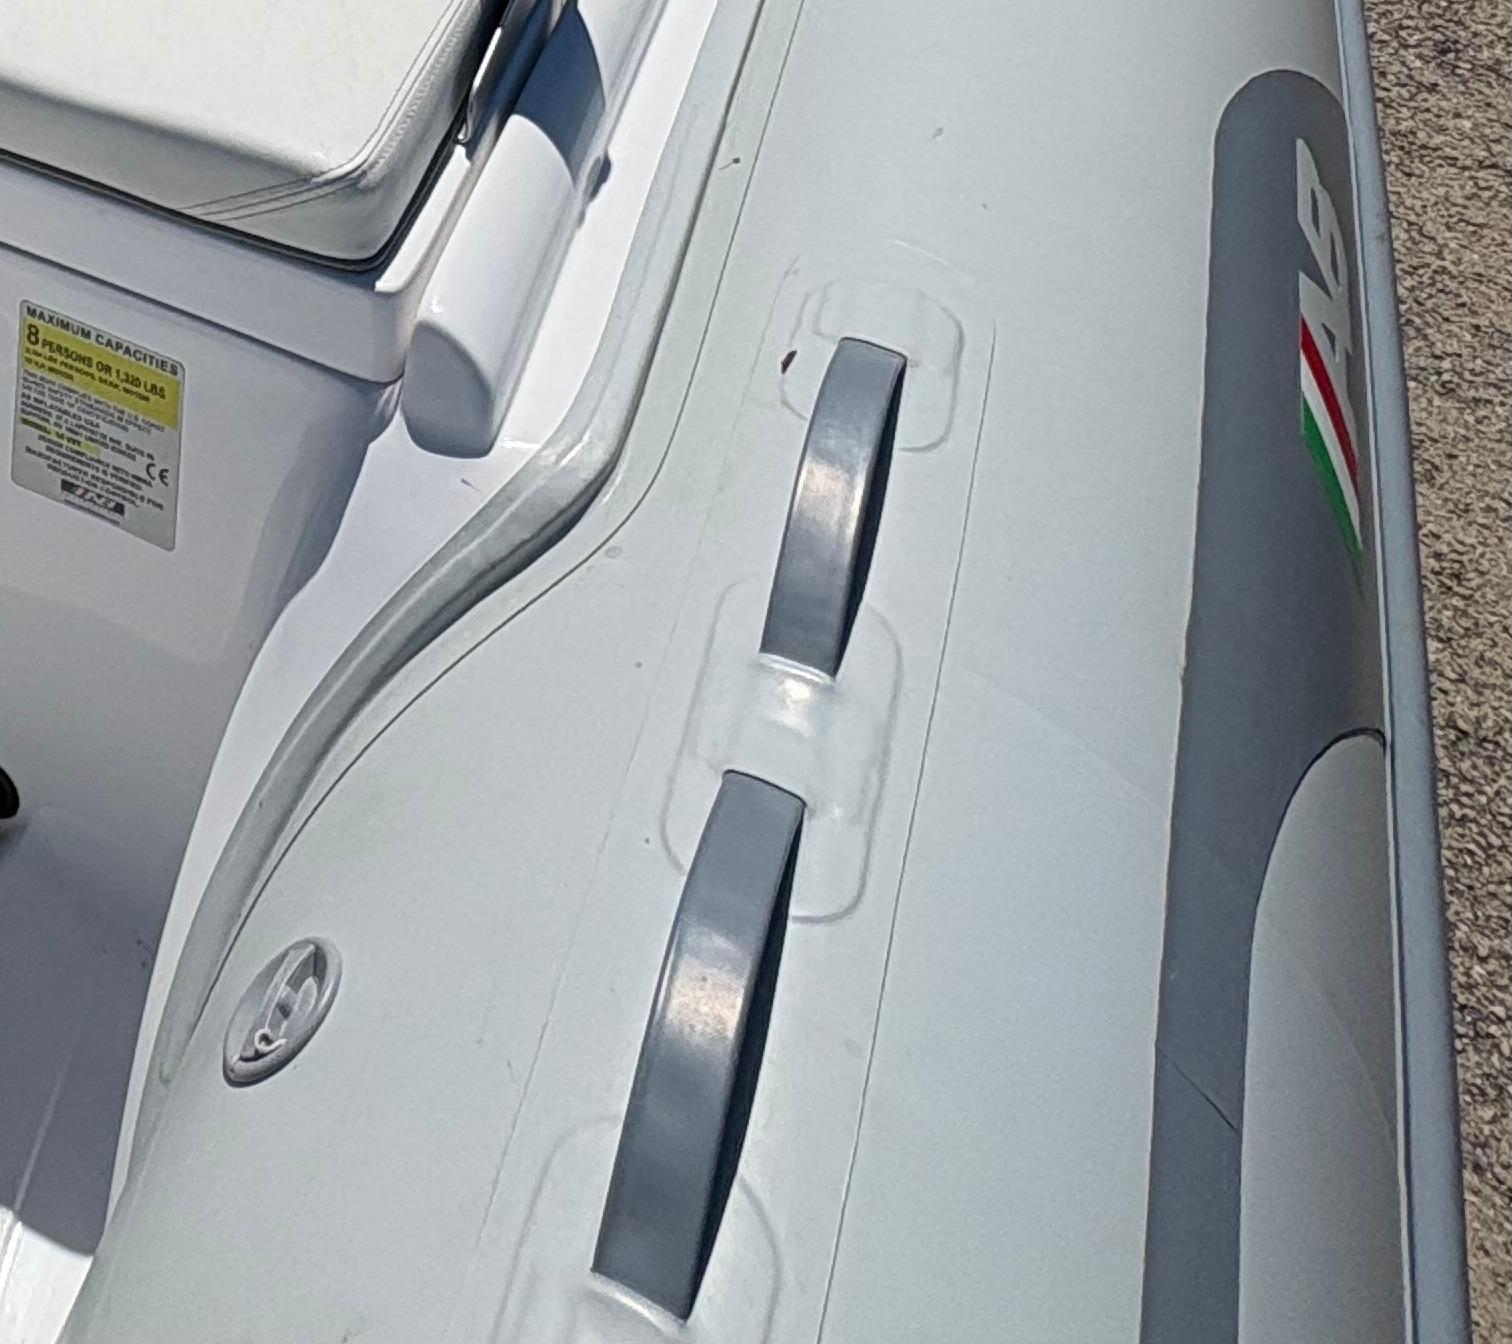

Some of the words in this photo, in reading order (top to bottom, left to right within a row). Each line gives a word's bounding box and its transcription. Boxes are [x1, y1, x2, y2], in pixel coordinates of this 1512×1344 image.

[26, 305, 92, 340] MAXIMUM
[95, 333, 178, 377] CAPACITIES
[26, 323, 40, 346] 8
[41, 338, 94, 368] PERSONS
[95, 360, 112, 377] OR
[143, 378, 166, 400] LBS
